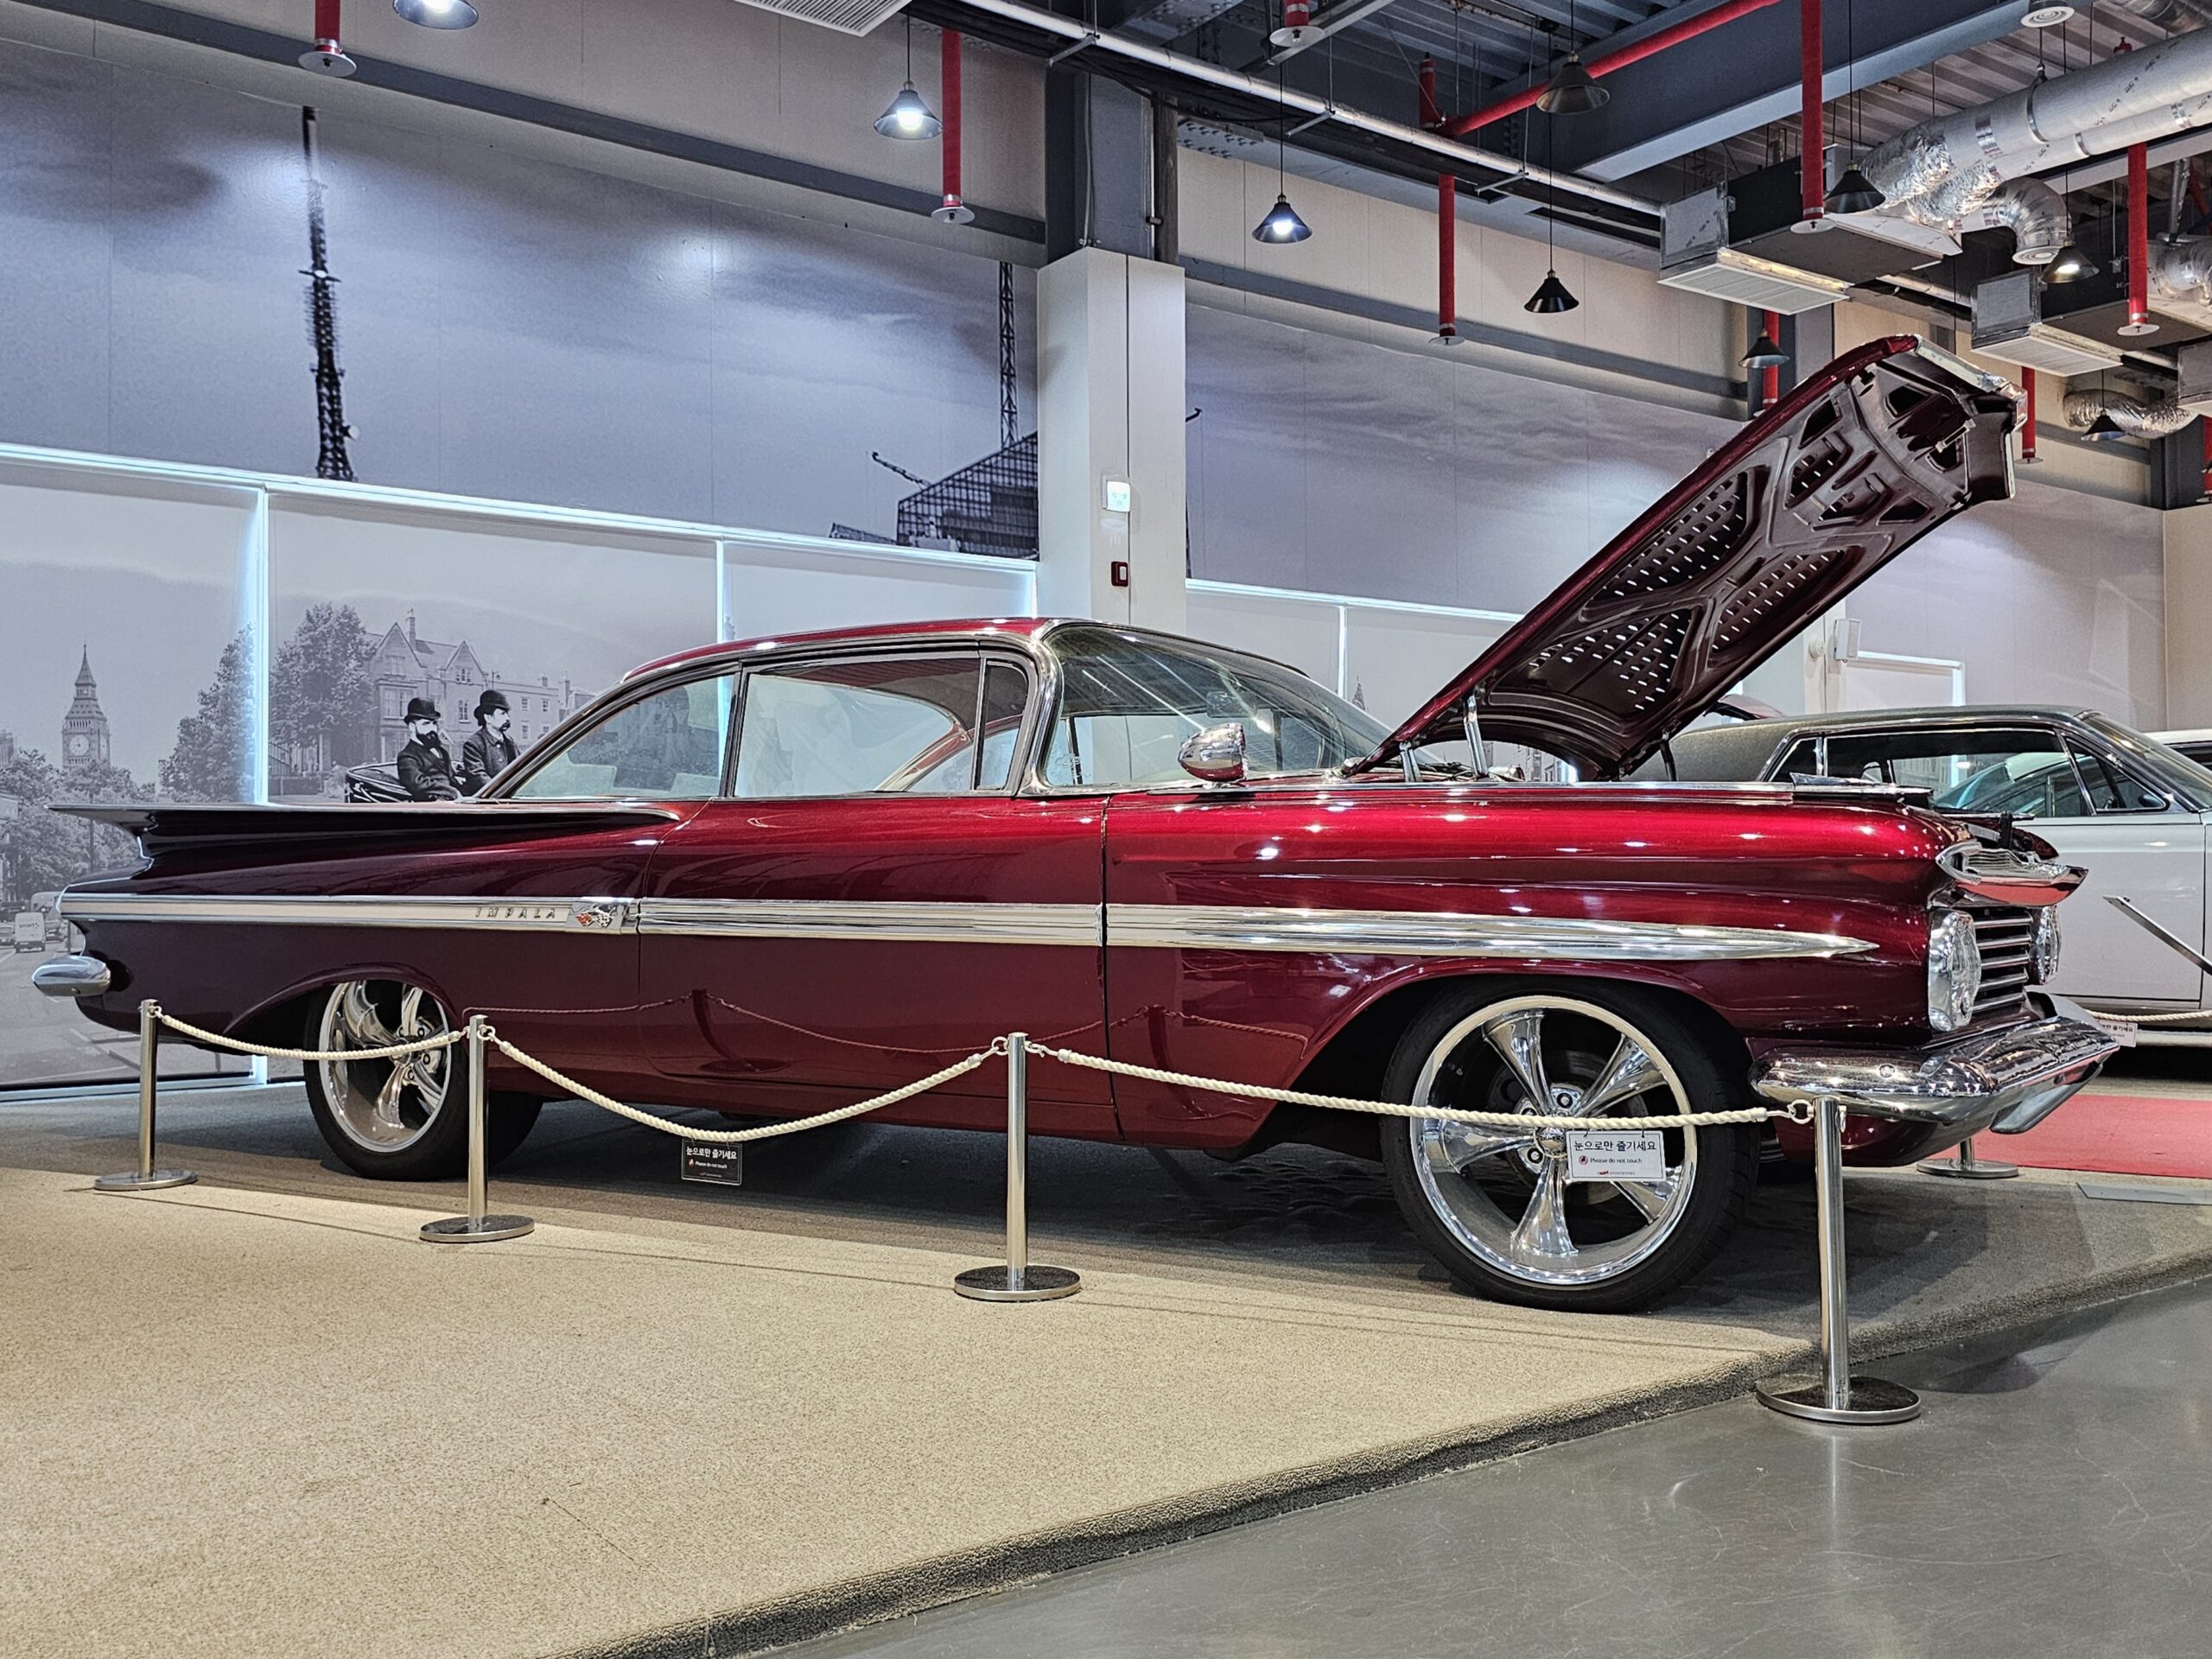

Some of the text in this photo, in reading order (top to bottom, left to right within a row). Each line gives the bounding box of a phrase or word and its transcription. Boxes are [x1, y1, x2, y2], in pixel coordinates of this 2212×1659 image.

[474, 906, 556, 918] IMPALA
[1573, 1141, 1657, 1152] 눈으로만 즐기세요
[686, 1146, 737, 1160] 눈으로만 즐기세요
